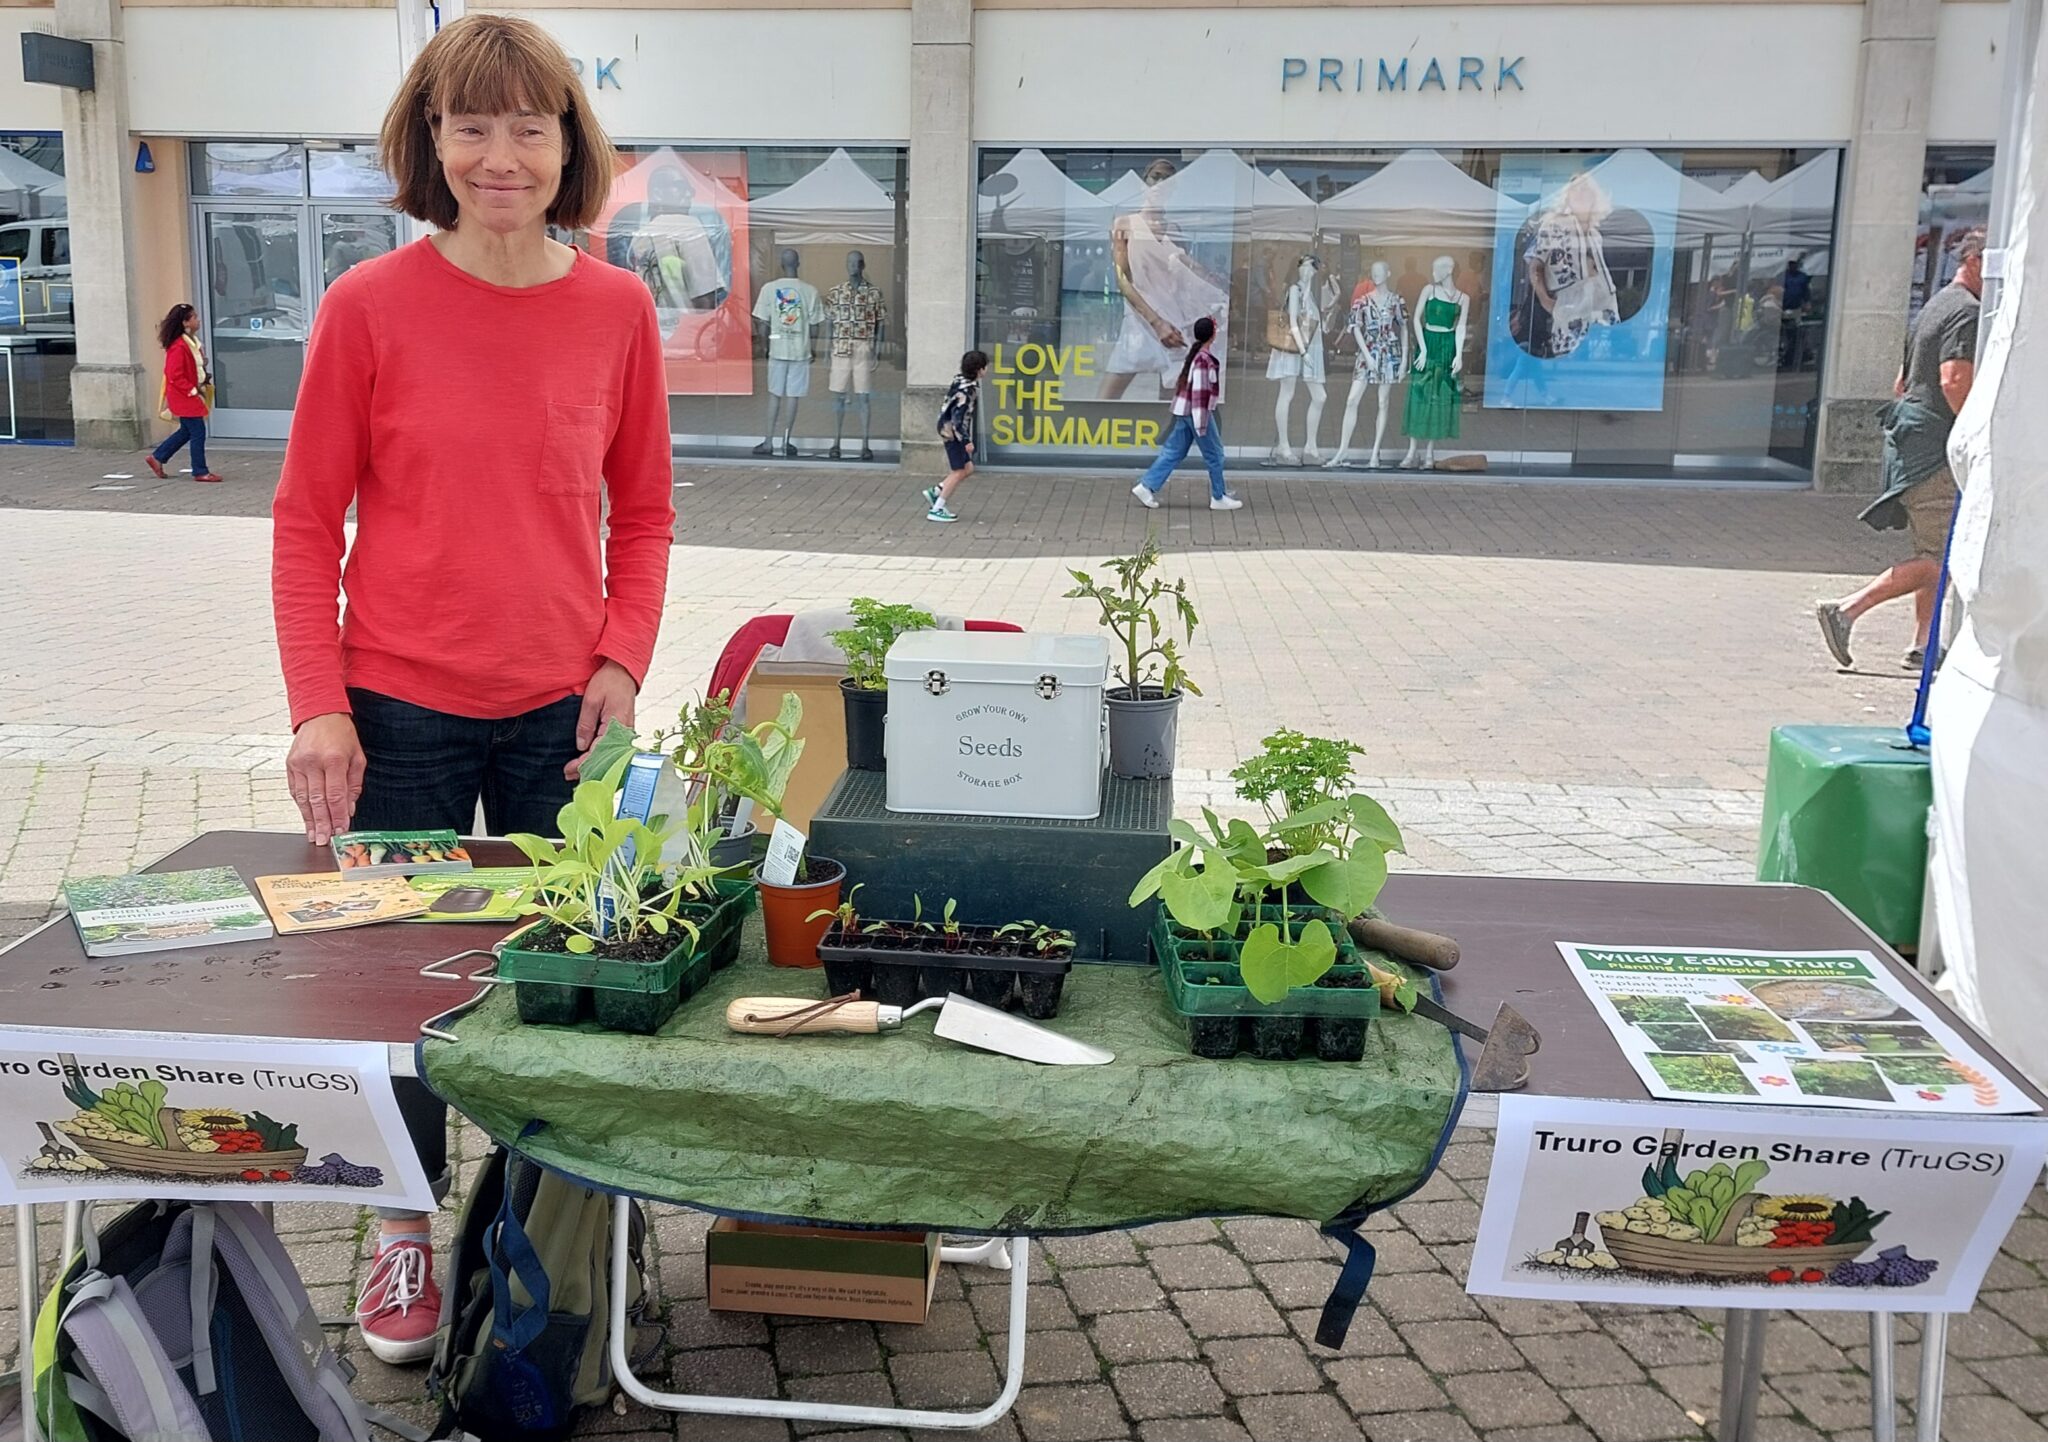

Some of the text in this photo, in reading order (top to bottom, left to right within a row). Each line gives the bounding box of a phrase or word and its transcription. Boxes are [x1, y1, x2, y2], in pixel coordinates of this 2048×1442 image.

[1281, 56, 1525, 92] PRIMARK
[994, 343, 1096, 377] LOVE
[992, 379, 1065, 411] THE
[991, 414, 1160, 449] SUMMER
[955, 704, 1029, 724] GROW YOUR OWN
[959, 735, 1023, 758] Seeds
[957, 770, 1023, 788] STORAGE BOX
[91, 903, 250, 921] Perennial Gardening
[1587, 951, 1856, 970] Wildly Edible Truro
[1607, 962, 1676, 973] Planting
[1706, 966, 1762, 975] People
[1781, 968, 1847, 976] Wildlife
[1590, 972, 1642, 980] Please
[1616, 980, 1660, 988] plant
[0, 1059, 359, 1095] ro Garden Share (TruGS)
[1535, 1130, 2005, 1177] Truro Garden Share (TruGS)
